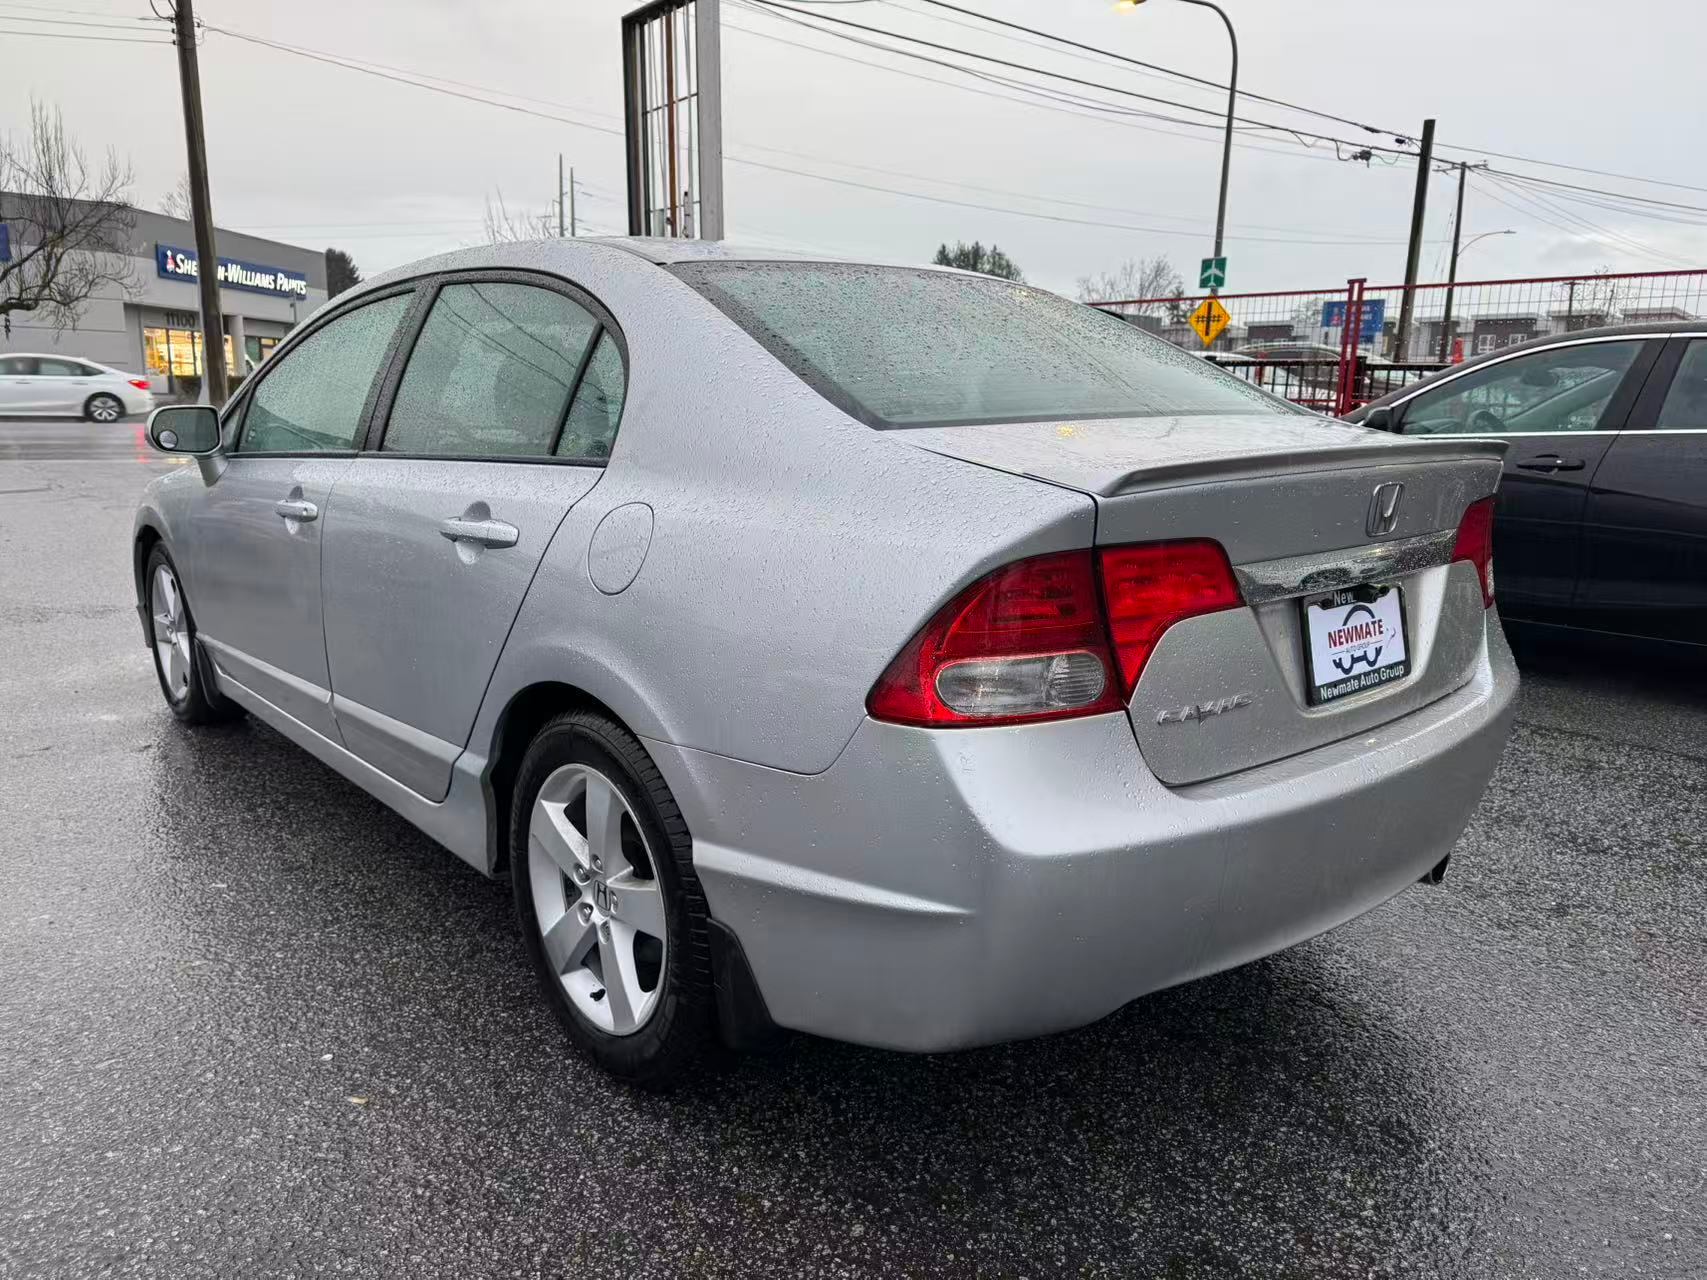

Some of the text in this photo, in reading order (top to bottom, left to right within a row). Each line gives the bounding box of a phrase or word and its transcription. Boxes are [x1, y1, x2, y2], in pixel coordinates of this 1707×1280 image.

[175, 253, 306, 295] SHEN-WILLIAMS PAINTS
[1328, 619, 1384, 649] NEWMATE
[1320, 664, 1405, 700] Newmate Auto Group
